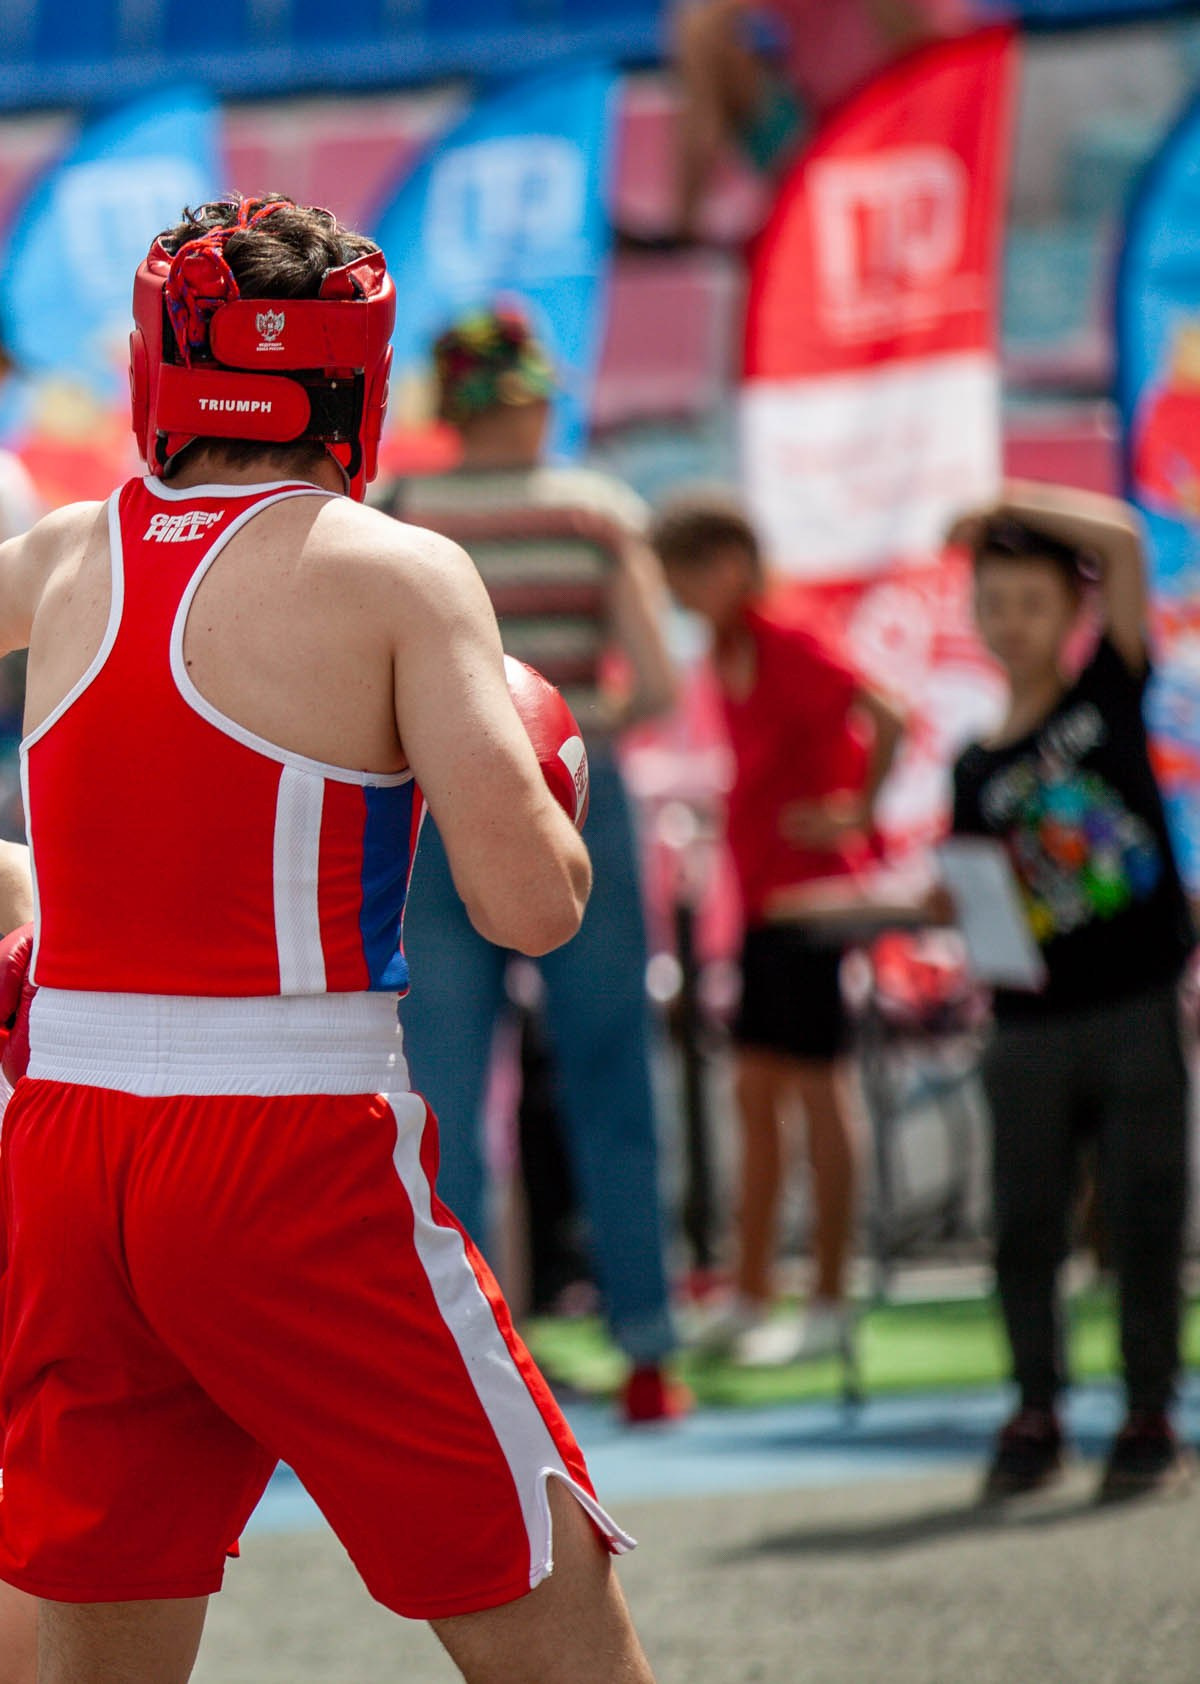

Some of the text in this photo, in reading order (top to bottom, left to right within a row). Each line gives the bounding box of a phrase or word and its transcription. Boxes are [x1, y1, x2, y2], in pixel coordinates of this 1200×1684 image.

[199, 398, 272, 413] TRIUMPH
[150, 510, 224, 528] GREEN
[143, 523, 205, 543] HILL
